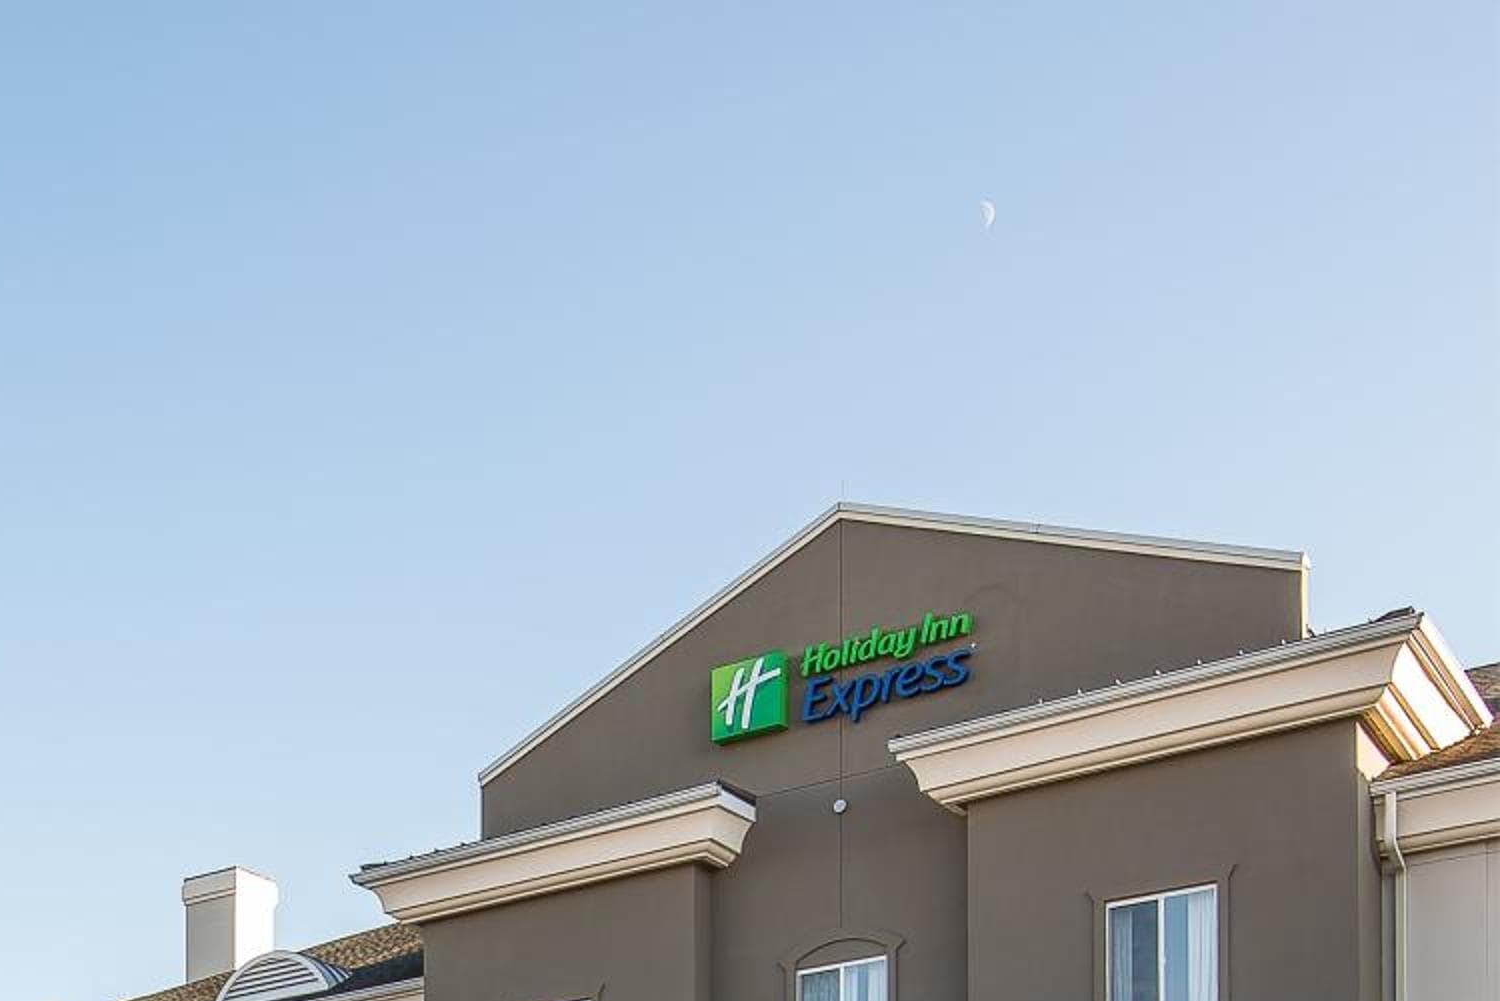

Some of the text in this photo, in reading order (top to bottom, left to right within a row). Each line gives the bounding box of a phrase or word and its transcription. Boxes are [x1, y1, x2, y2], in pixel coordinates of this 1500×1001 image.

[801, 611, 973, 676] Holiday Inn
[801, 649, 975, 724] Express
